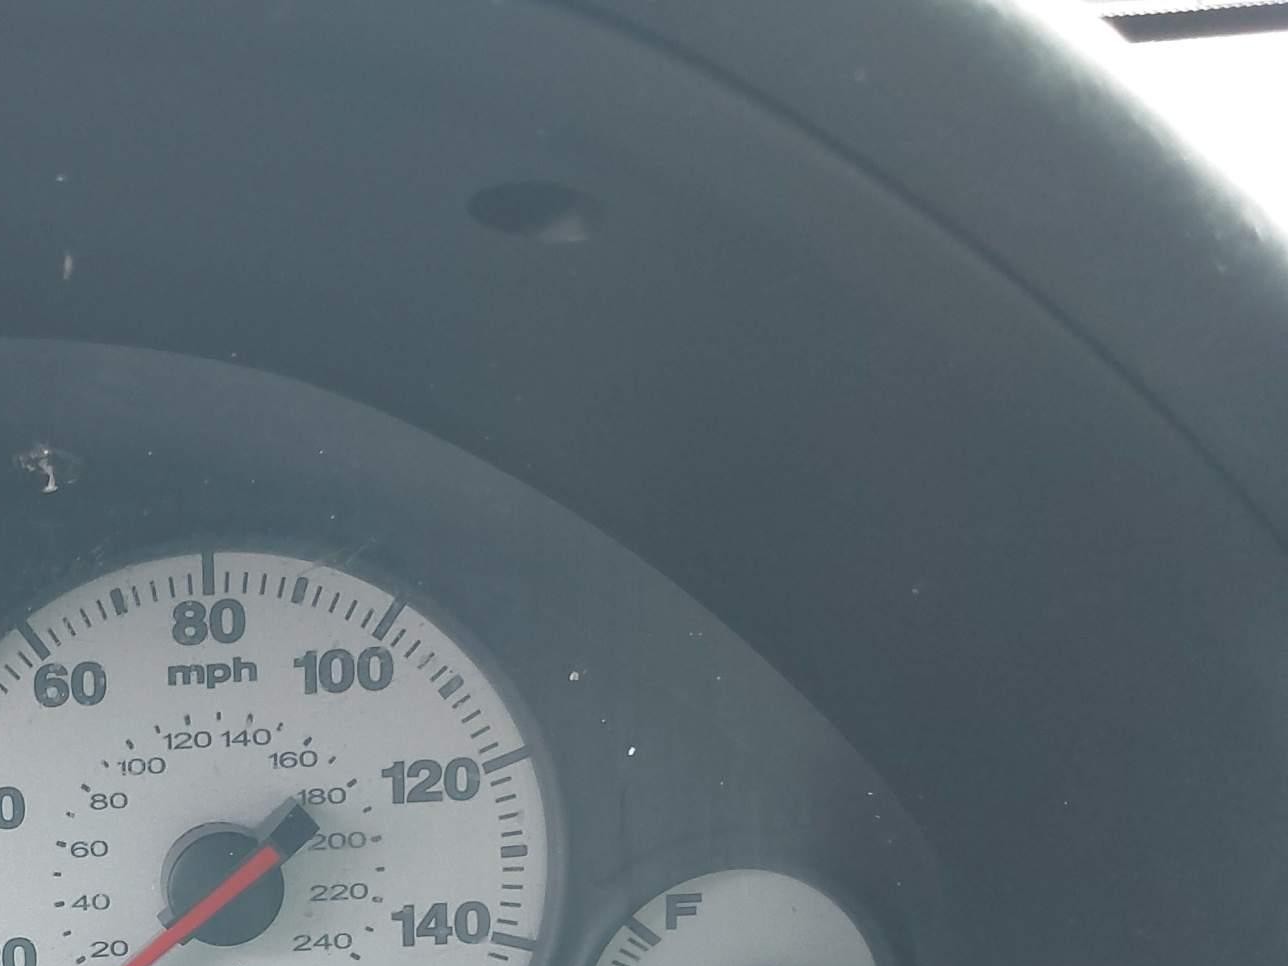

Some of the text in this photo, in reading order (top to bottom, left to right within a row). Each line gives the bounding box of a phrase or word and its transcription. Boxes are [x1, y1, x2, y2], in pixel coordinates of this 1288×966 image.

[171, 598, 246, 646] 80
[167, 656, 258, 689] mph
[293, 645, 394, 695] 100
[33, 660, 107, 708] 60
[162, 730, 212, 751] 120
[221, 728, 272, 748] 140
[117, 756, 166, 776] 100
[269, 750, 318, 769] 160
[381, 756, 481, 805] 120
[89, 792, 129, 811] 80
[297, 787, 347, 806] 180
[70, 840, 109, 858] 60
[312, 831, 367, 851] 200
[71, 893, 111, 911] 40
[310, 883, 369, 903] 220
[665, 892, 703, 931] F
[391, 900, 492, 948] 140
[90, 940, 130, 958] 20
[292, 932, 353, 952] 240
